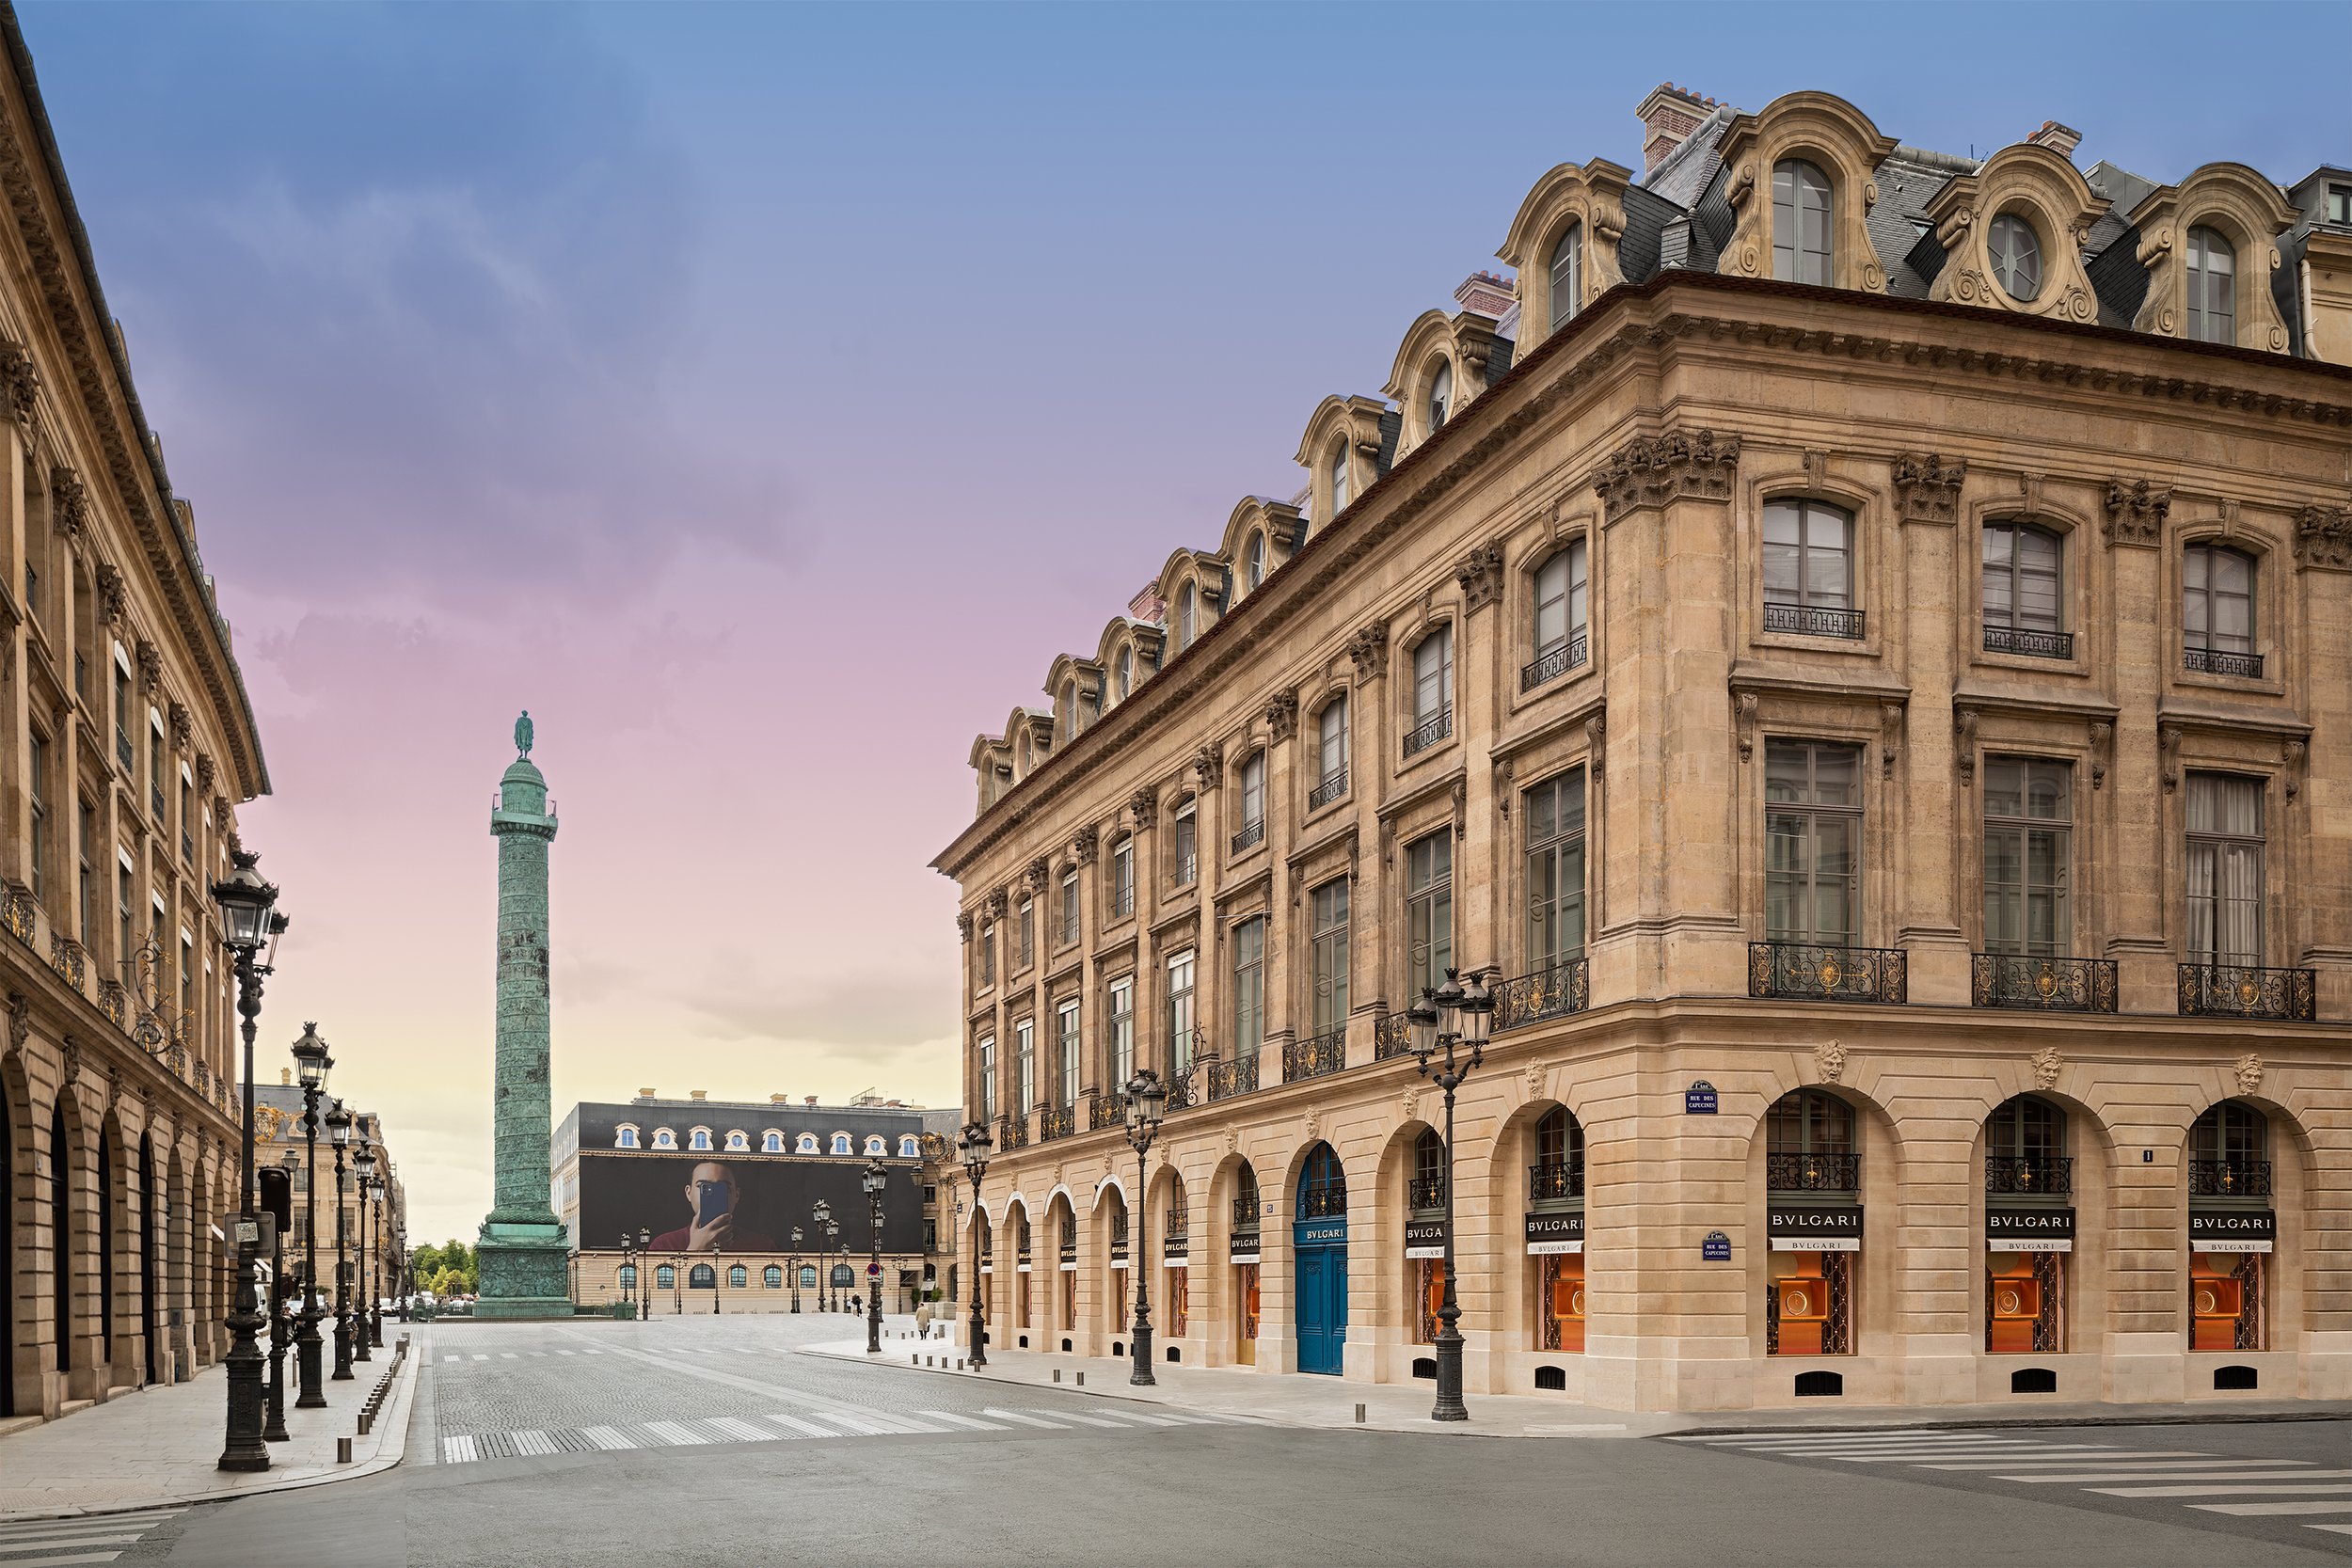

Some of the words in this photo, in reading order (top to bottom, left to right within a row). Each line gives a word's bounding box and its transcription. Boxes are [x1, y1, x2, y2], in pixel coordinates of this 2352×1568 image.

[1528, 1219, 1583, 1232] BVLGARI
[1772, 1214, 1857, 1227] BVLGARI
[1990, 1216, 2070, 1227] BVLGARI
[2193, 1218, 2271, 1228] BVLGARI
[1307, 1228, 1343, 1240] BVLGARI
[1407, 1227, 1445, 1239] BVLGA
